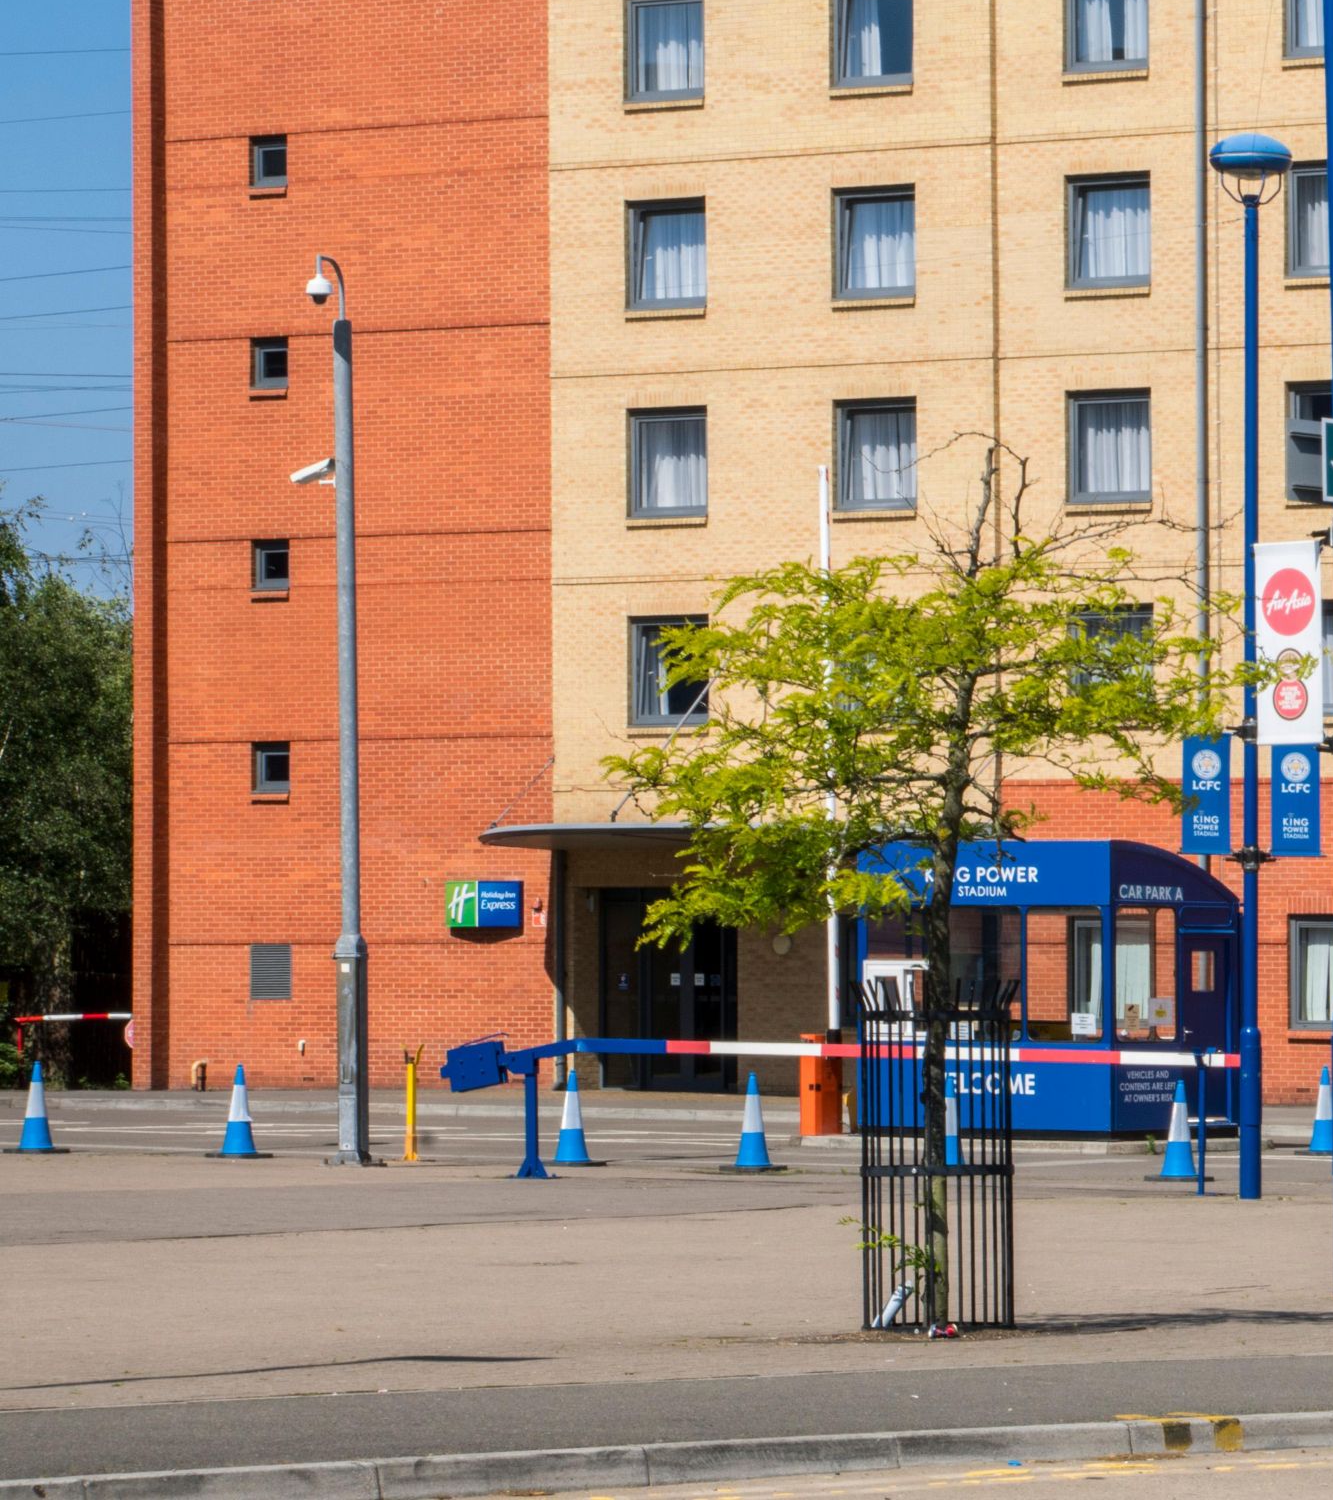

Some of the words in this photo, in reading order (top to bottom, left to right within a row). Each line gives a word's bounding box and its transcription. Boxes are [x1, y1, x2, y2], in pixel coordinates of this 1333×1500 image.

[1192, 780, 1221, 791] LCFC
[1281, 783, 1311, 794] LCFC
[1193, 815, 1219, 824] KING
[1282, 817, 1309, 826] KING
[924, 866, 970, 883] KG
[976, 866, 1039, 883] POWER
[481, 891, 504, 900] Holiday
[957, 886, 1007, 897] STADIUM
[1119, 884, 1143, 899] CAR
[1145, 885, 1172, 900] PARK
[1175, 886, 1184, 901] A
[480, 900, 516, 911] Express
[1127, 1070, 1154, 1079] VEHICLES
[1155, 1070, 1169, 1078] AND
[945, 1072, 1036, 1095] ELCOME
[1120, 1082, 1150, 1091] CONTENTS
[1152, 1082, 1164, 1090] ARE
[1164, 1081, 1176, 1090] LEFT
[1124, 1094, 1132, 1103] AT
[1133, 1094, 1160, 1102] OWNER'S
[1161, 1093, 1173, 1102] RISK
